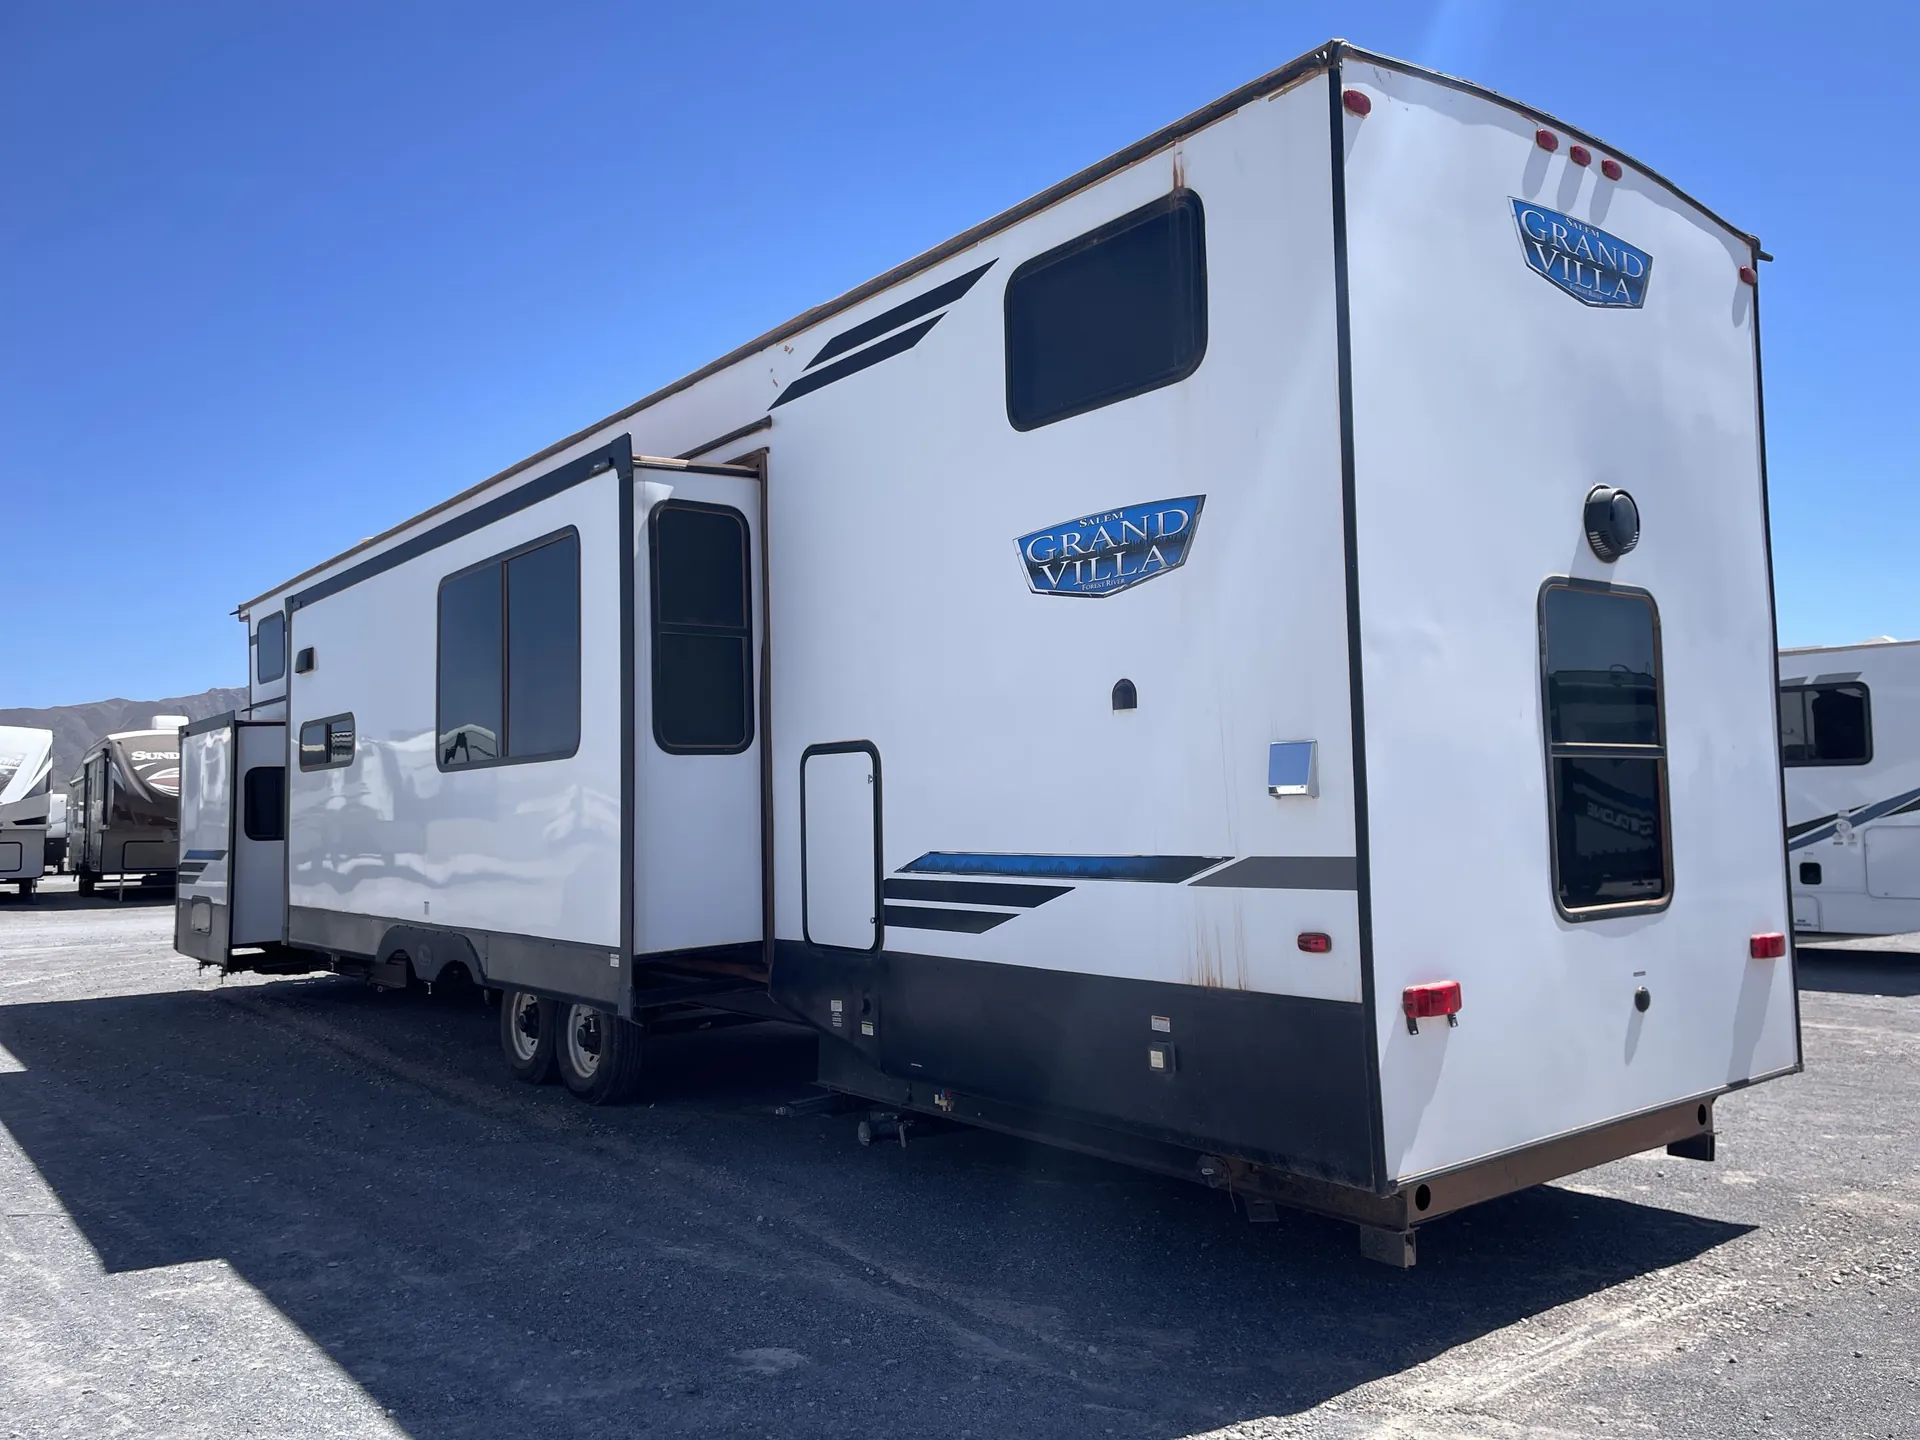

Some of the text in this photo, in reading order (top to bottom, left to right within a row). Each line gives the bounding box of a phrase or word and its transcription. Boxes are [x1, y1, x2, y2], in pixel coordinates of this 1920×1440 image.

[1520, 208, 1644, 279] GRAND
[1565, 217, 1600, 239] SALEM
[1531, 240, 1633, 304] VILLA
[1026, 508, 1190, 564] GRAND
[1079, 511, 1124, 528] SALEM
[1038, 544, 1172, 590] VILLA
